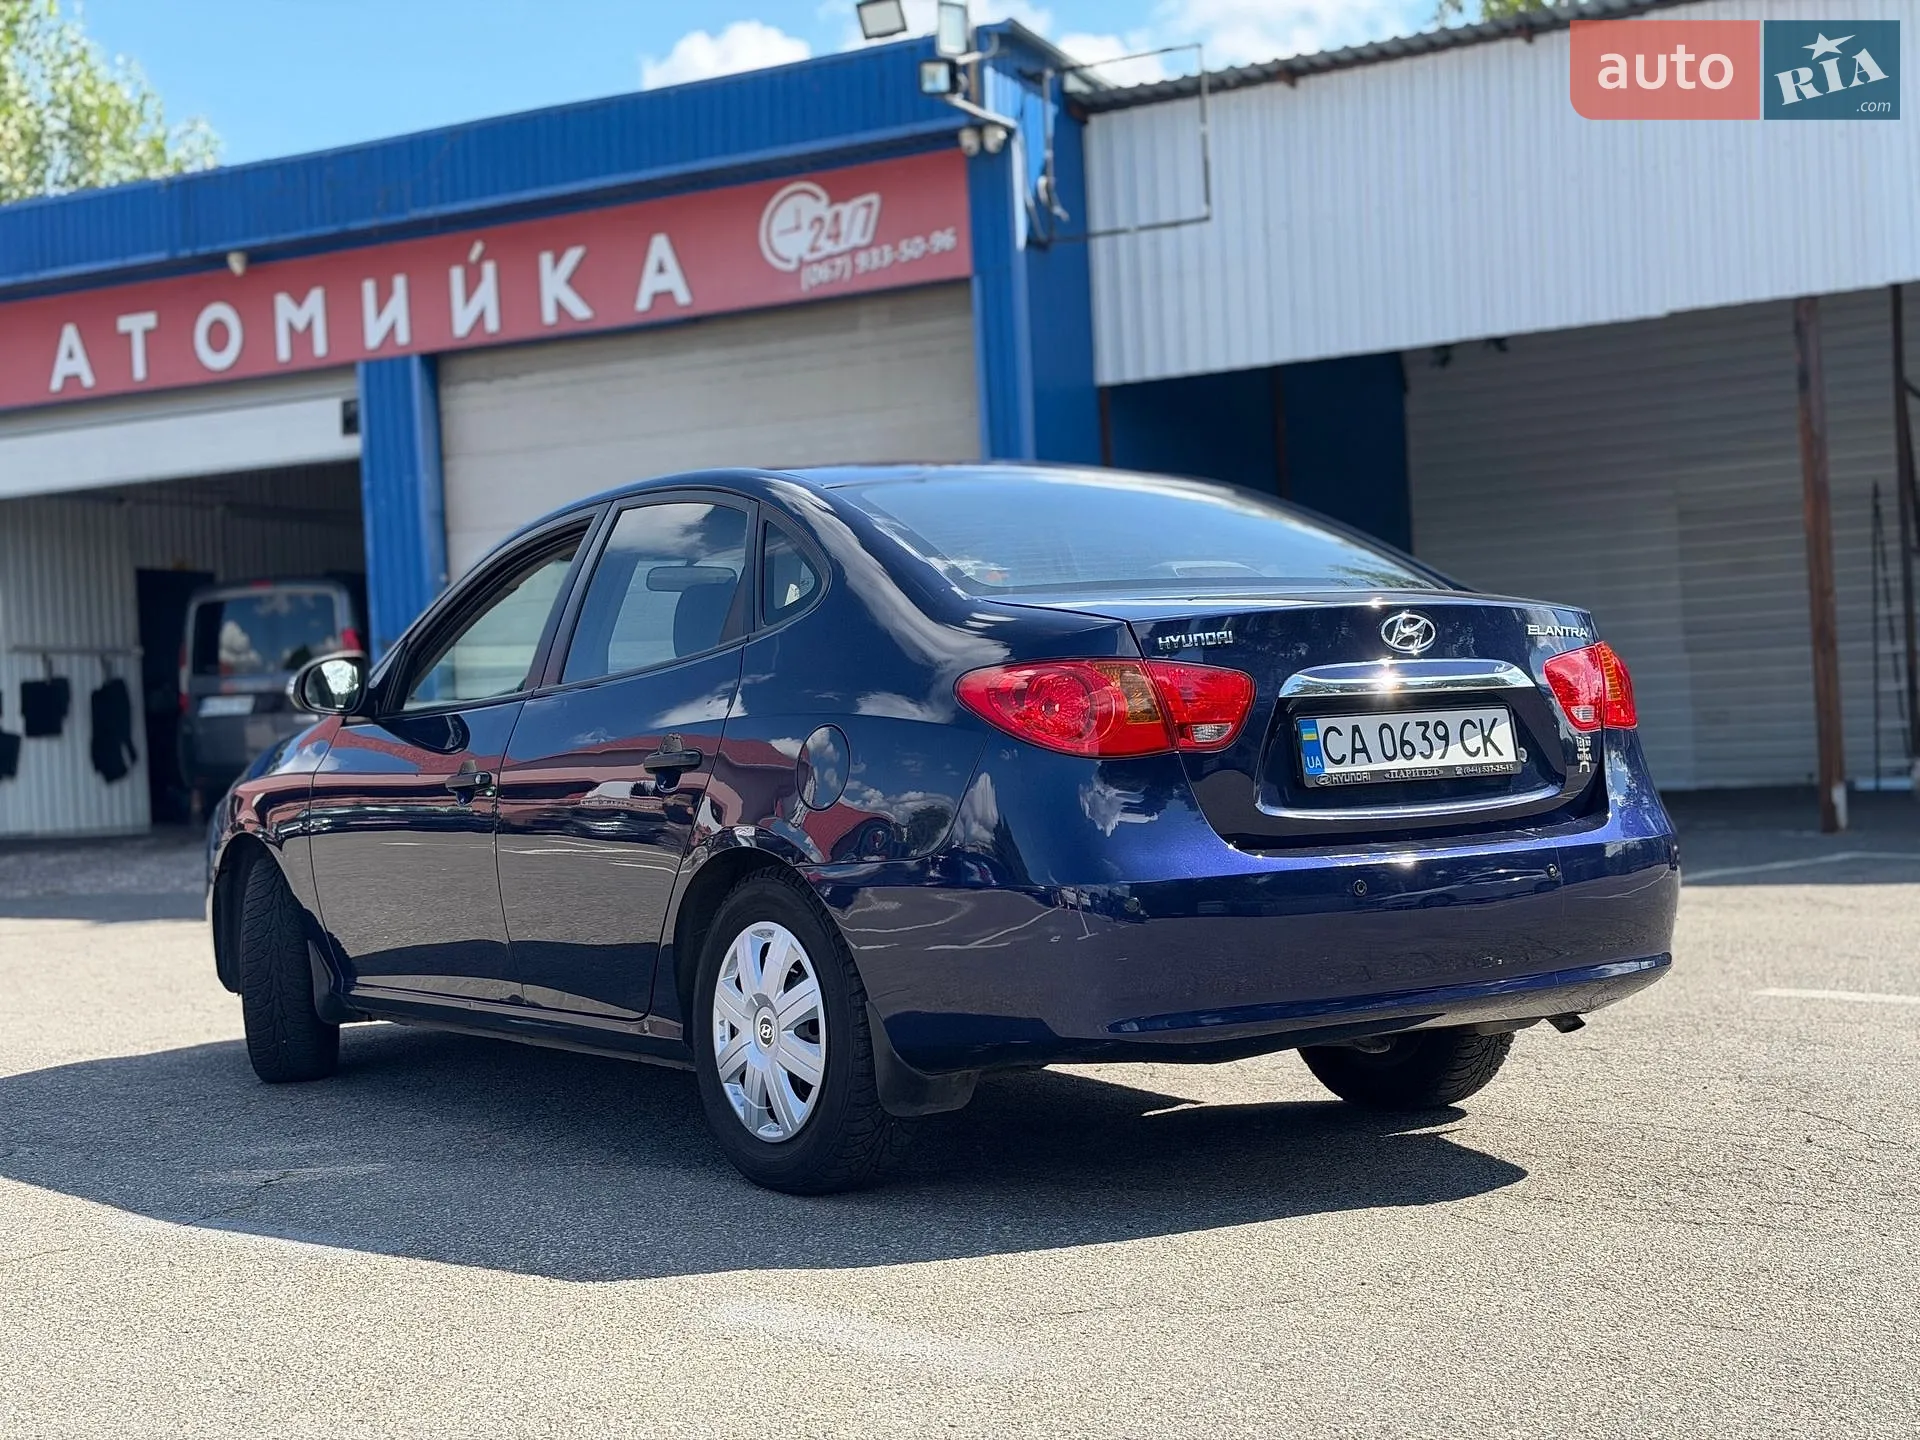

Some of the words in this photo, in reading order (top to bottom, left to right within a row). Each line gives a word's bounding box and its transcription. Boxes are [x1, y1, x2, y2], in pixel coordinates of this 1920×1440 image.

[49, 233, 692, 392] АТОМИЙКА
[1527, 624, 1588, 638] ELANTRA
[1158, 630, 1234, 650] HYUNDAI
[1378, 720, 1451, 762] 0639
[1306, 756, 1323, 769] UA
[1332, 772, 1371, 784] HYUNDAI
